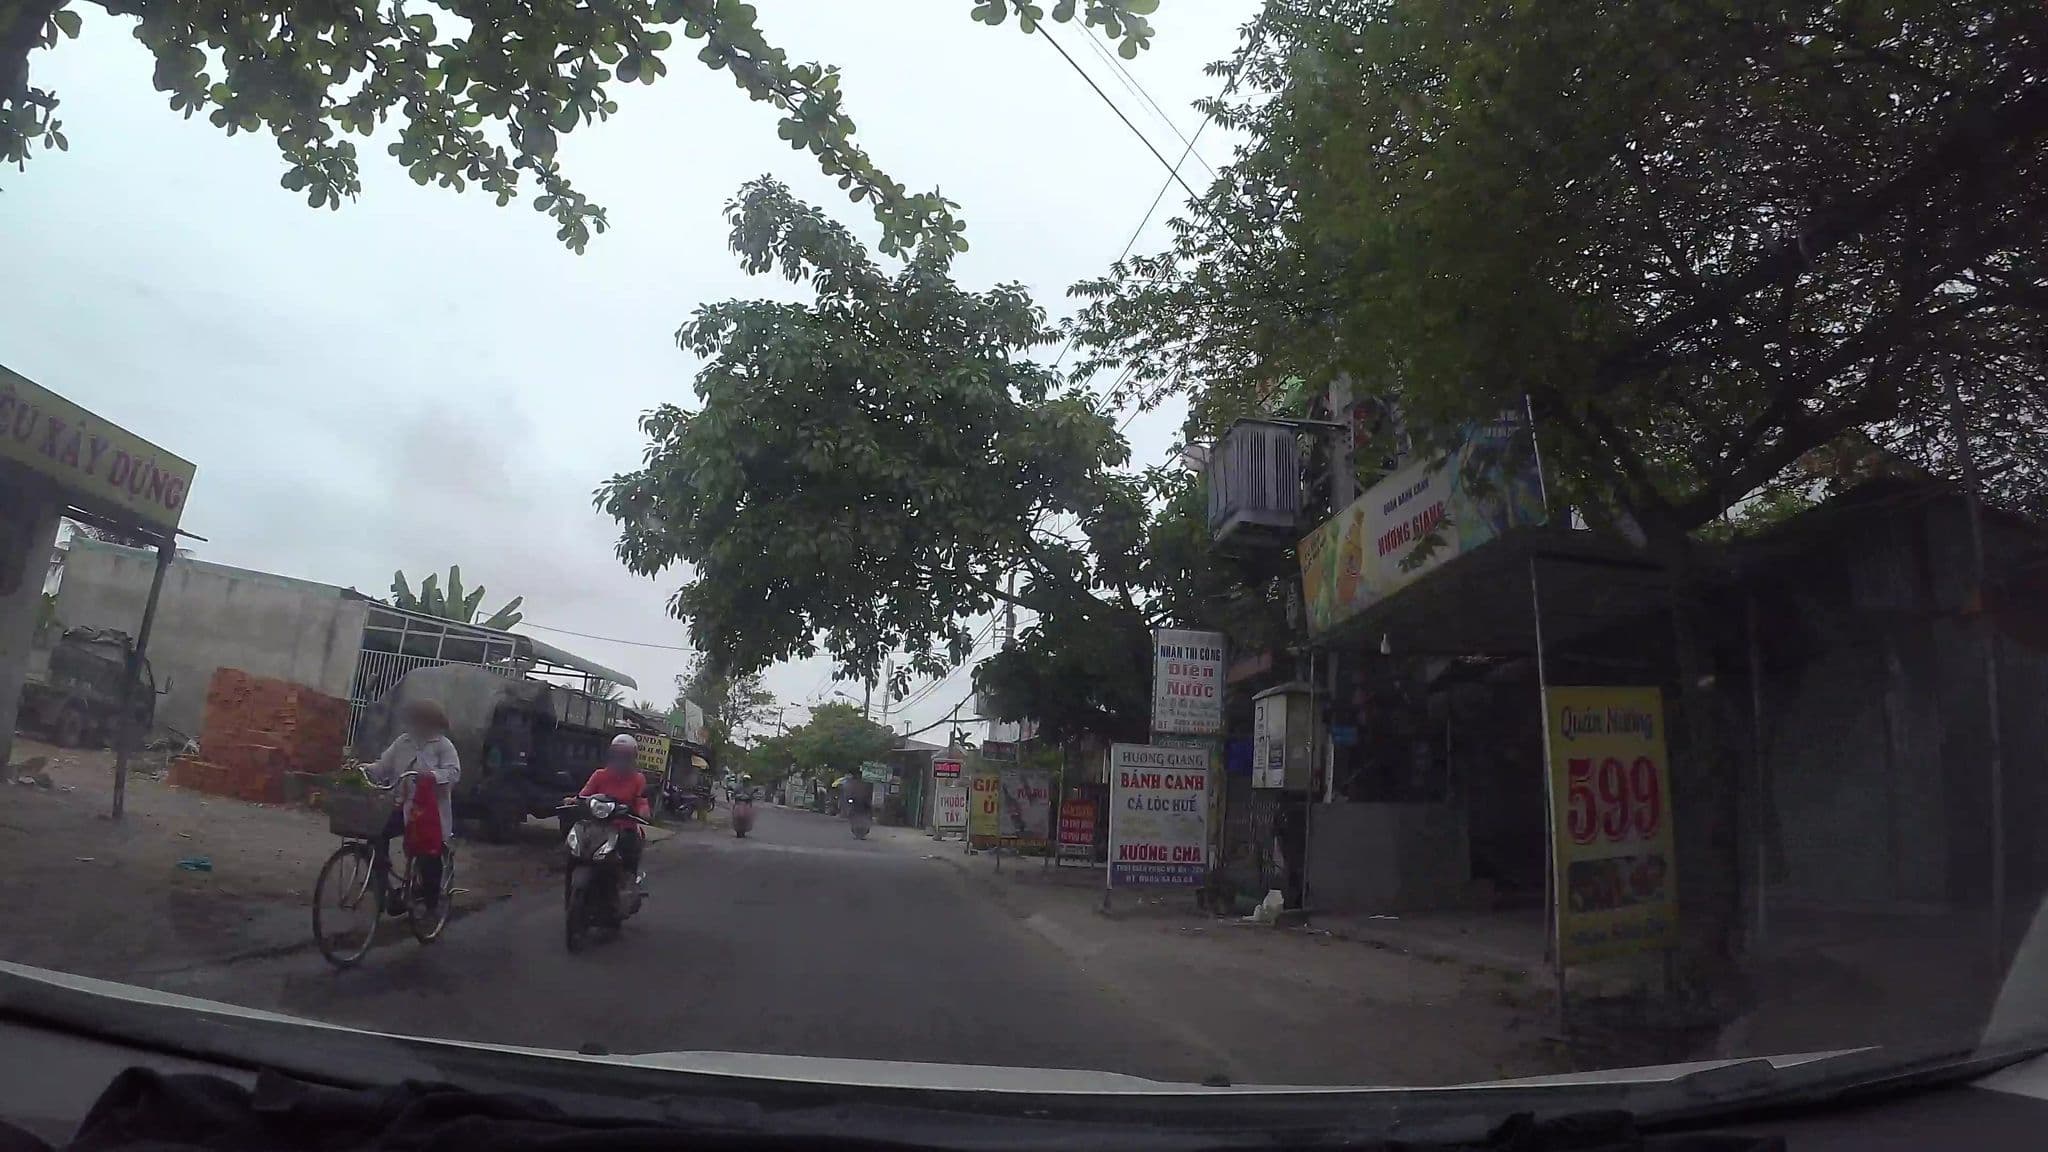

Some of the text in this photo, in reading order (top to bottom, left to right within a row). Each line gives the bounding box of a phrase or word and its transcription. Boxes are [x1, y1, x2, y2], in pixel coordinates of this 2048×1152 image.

[39, 415, 110, 475] XÂY
[110, 451, 185, 510] DỰNG
[1186, 646, 1197, 660] THI
[1560, 705, 1602, 742] Quán
[635, 735, 662, 746] ONDA
[1167, 753, 1204, 766] GIANG
[1120, 769, 1205, 791] BÁNH CANH
[1566, 755, 1661, 846] 599
